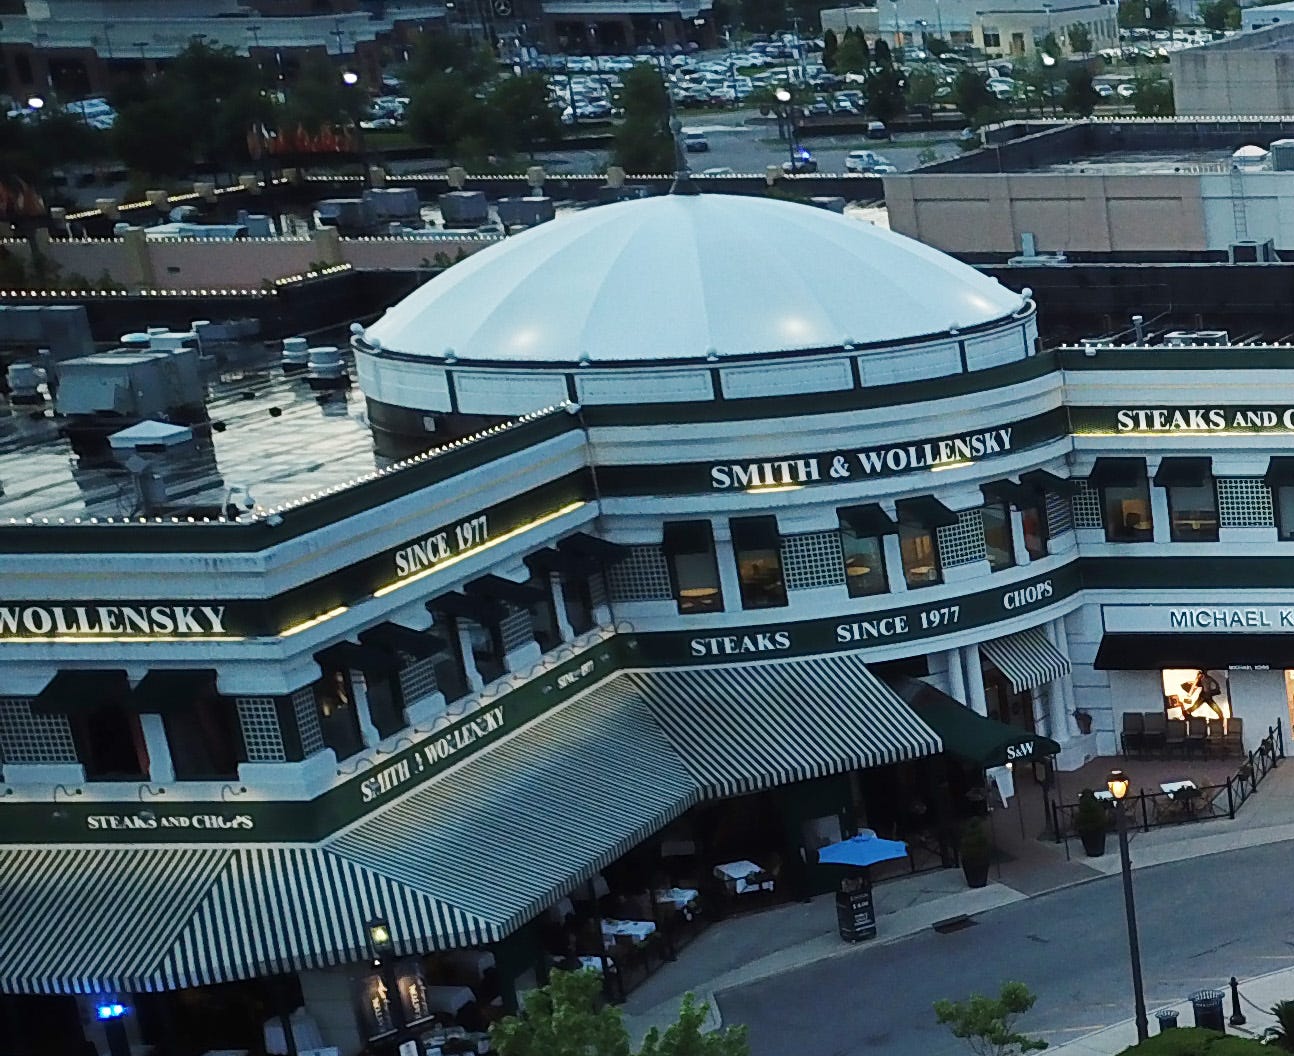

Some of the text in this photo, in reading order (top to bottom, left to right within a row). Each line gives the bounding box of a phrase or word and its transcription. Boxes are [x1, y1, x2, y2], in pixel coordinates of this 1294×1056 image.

[1117, 408, 1225, 431] STEAKS
[1233, 411, 1277, 427] AND
[711, 427, 1013, 489] SMITH & WOLLENSKY
[395, 515, 488, 577] SINCE 1977
[691, 579, 1054, 657] STEAKS SINCE 1977 CHOPS
[1170, 610, 1271, 628] MICHAEL
[1006, 741, 1034, 760] S&W
[161, 816, 190, 827] AND
